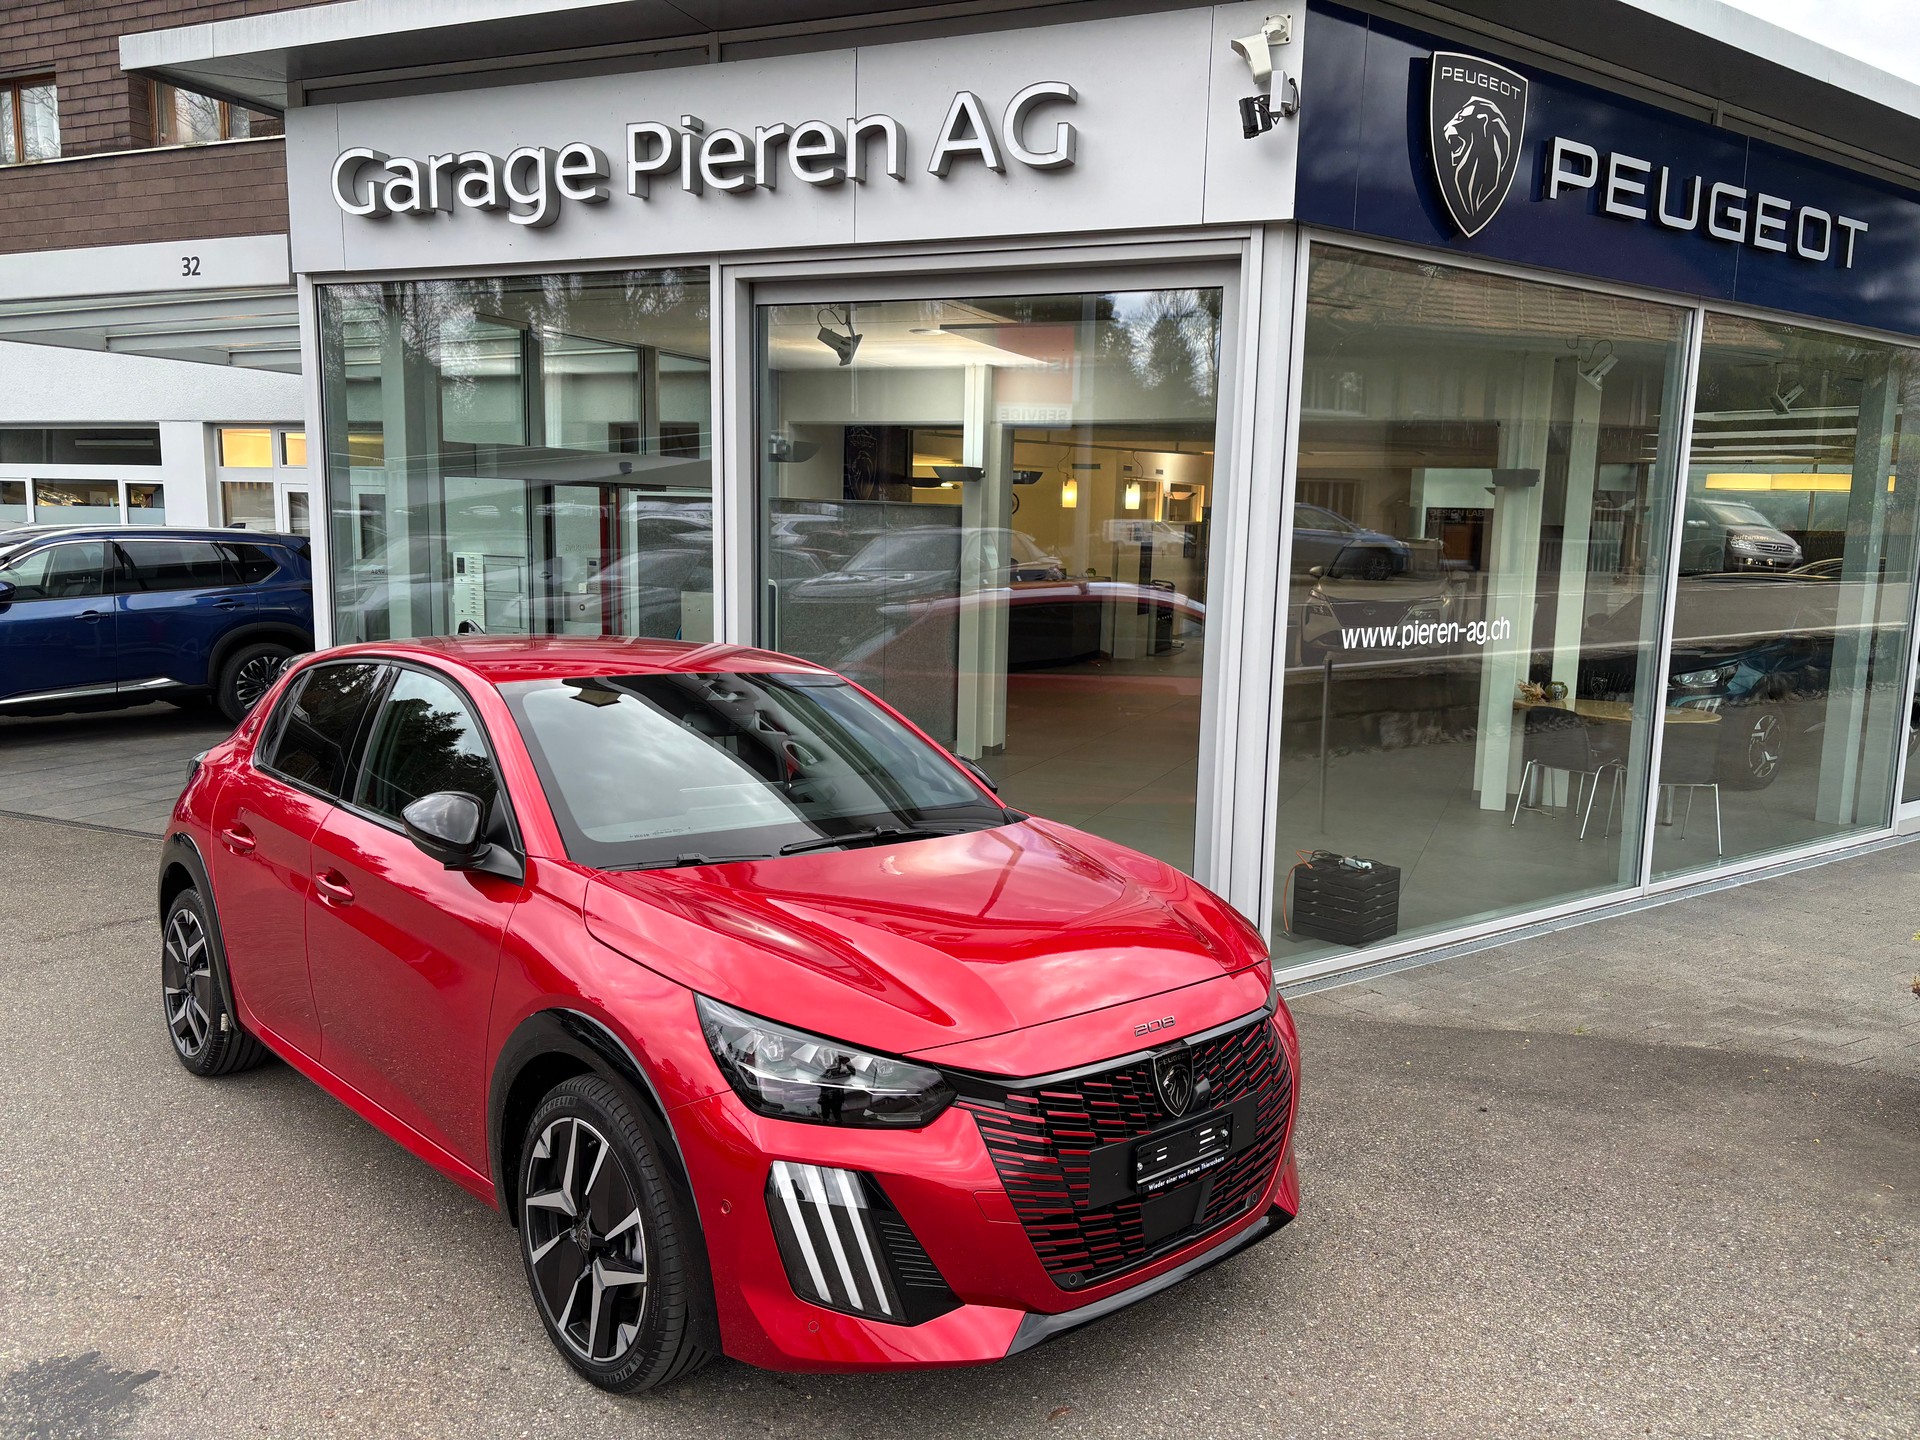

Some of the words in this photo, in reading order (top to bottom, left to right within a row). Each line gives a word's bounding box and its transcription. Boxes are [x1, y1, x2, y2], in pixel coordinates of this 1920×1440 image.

[1441, 67, 1520, 100] PEUGEOT
[331, 141, 608, 227] Garage
[626, 114, 907, 198] Pieren
[927, 80, 1078, 177] AG
[1548, 136, 1869, 269] PEUGEOT
[181, 256, 201, 276] 32
[1341, 616, 1511, 650] www.pieren-ag.ch
[1134, 1015, 1176, 1037] 208
